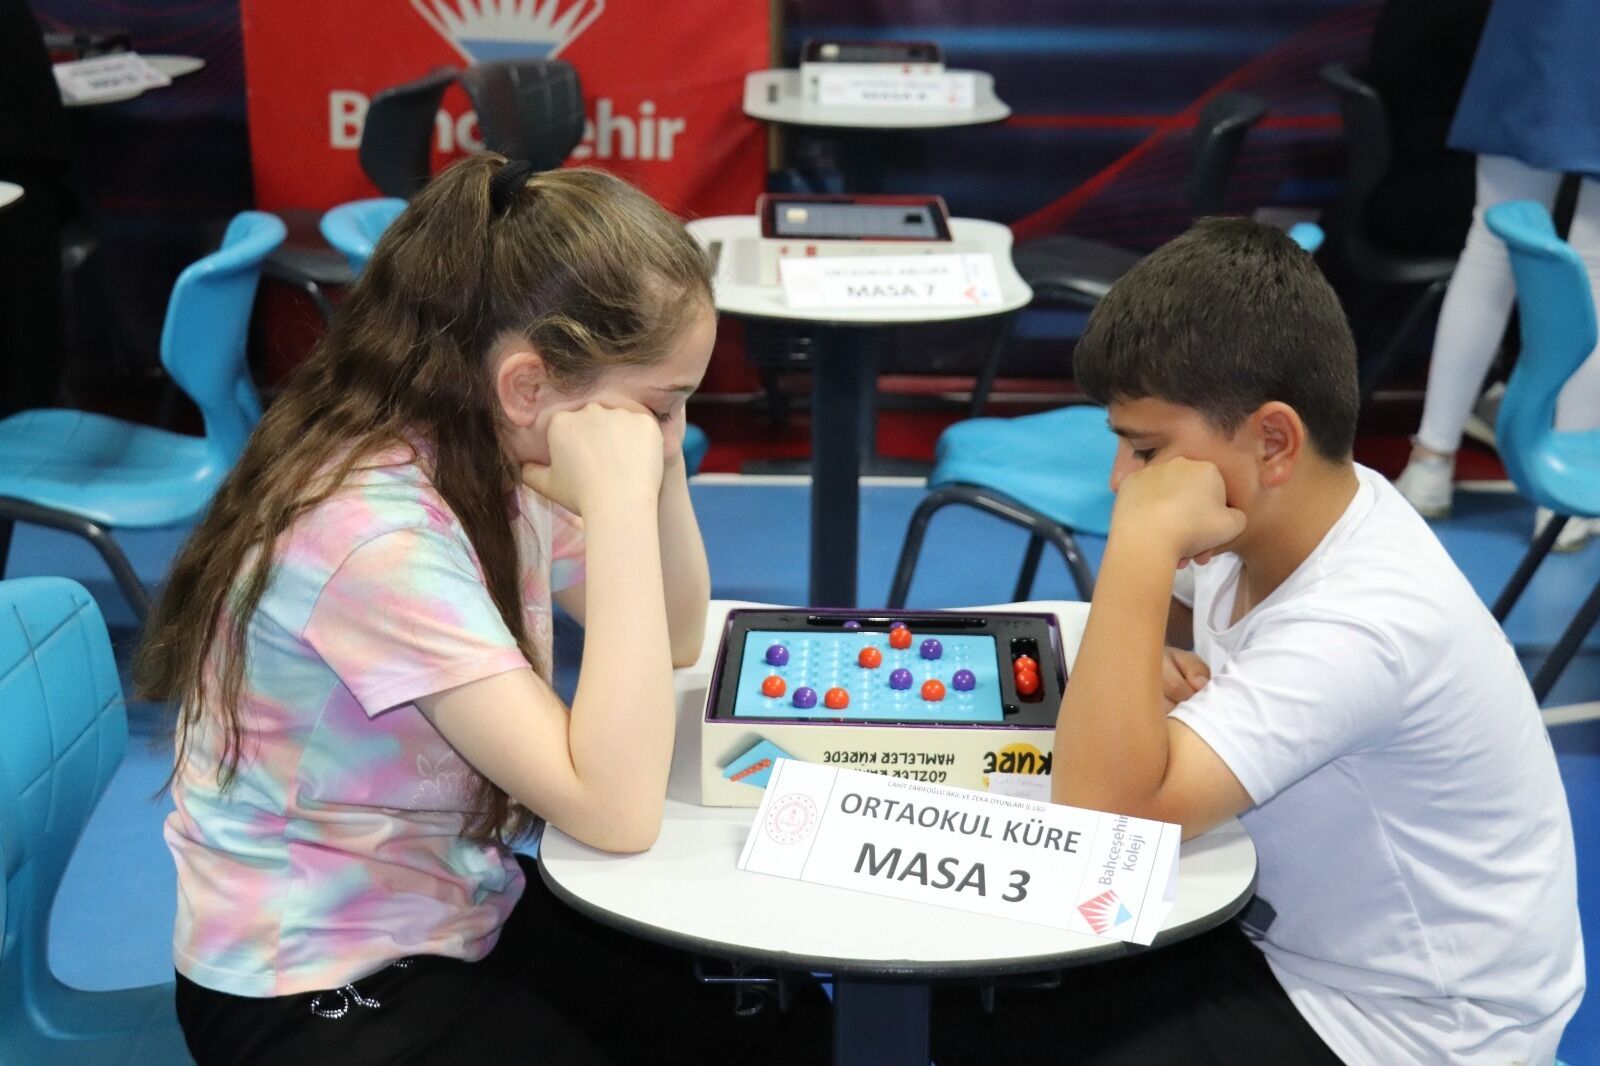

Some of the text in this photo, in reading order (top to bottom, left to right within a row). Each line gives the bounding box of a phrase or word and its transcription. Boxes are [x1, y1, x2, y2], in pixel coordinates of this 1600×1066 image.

[881, 751, 955, 766] HAMLELER
[840, 793, 993, 841] ORTAOKUL
[1002, 818, 1082, 854] KÜRE
[854, 842, 1031, 903] MASA 3
[1121, 833, 1146, 872] Koleji
